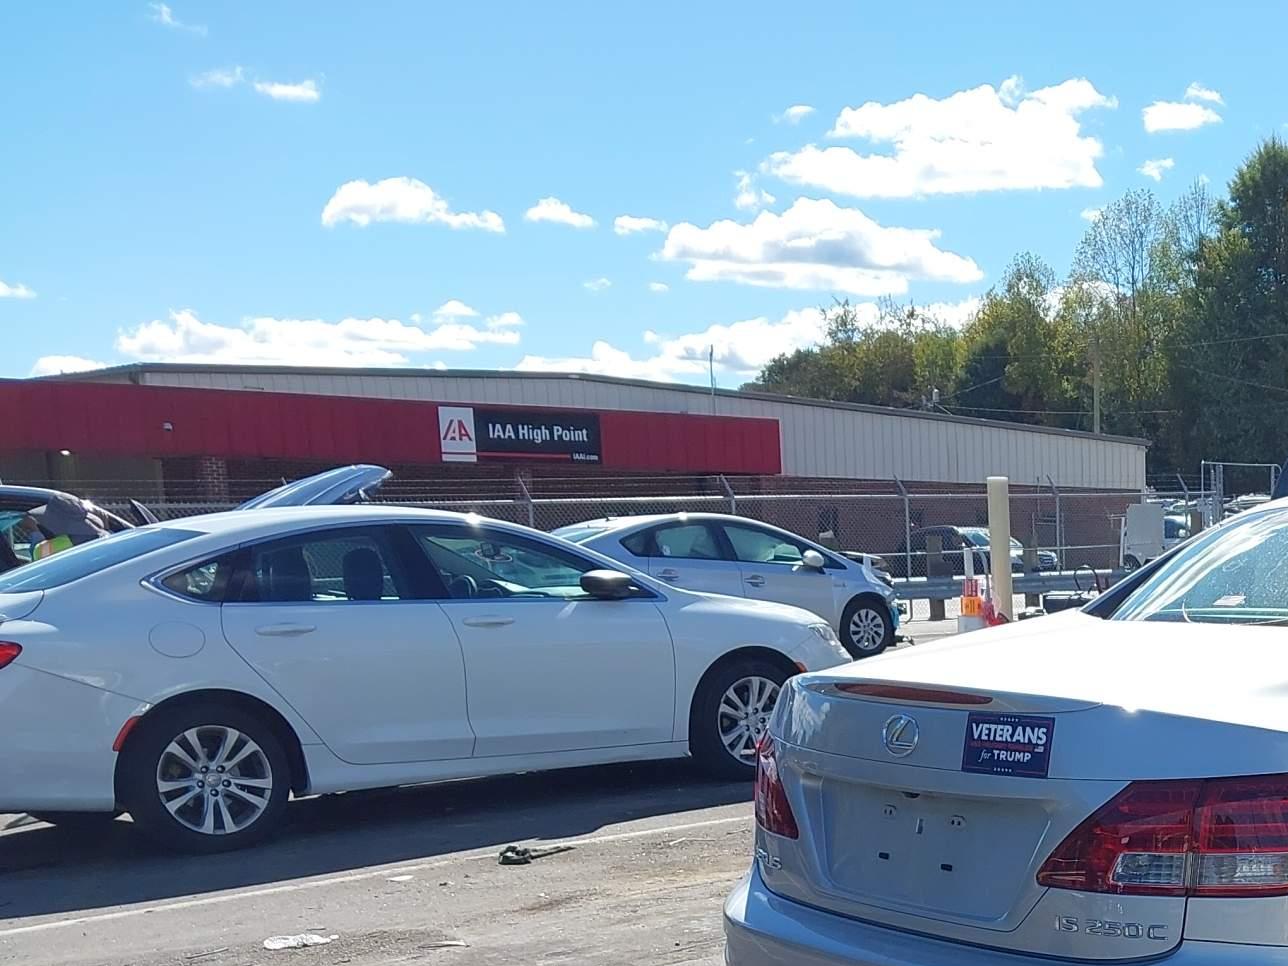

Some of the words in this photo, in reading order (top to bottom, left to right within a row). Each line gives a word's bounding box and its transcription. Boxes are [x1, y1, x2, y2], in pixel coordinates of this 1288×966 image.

[488, 422, 515, 440] IAA
[518, 424, 550, 444] High
[553, 425, 588, 443] Point
[971, 722, 1048, 745] VETERANS
[978, 749, 992, 763] for
[992, 749, 1032, 763] TRUMP
[1055, 914, 1079, 933] IS
[1084, 918, 1144, 939] 250
[1146, 924, 1169, 941] C
